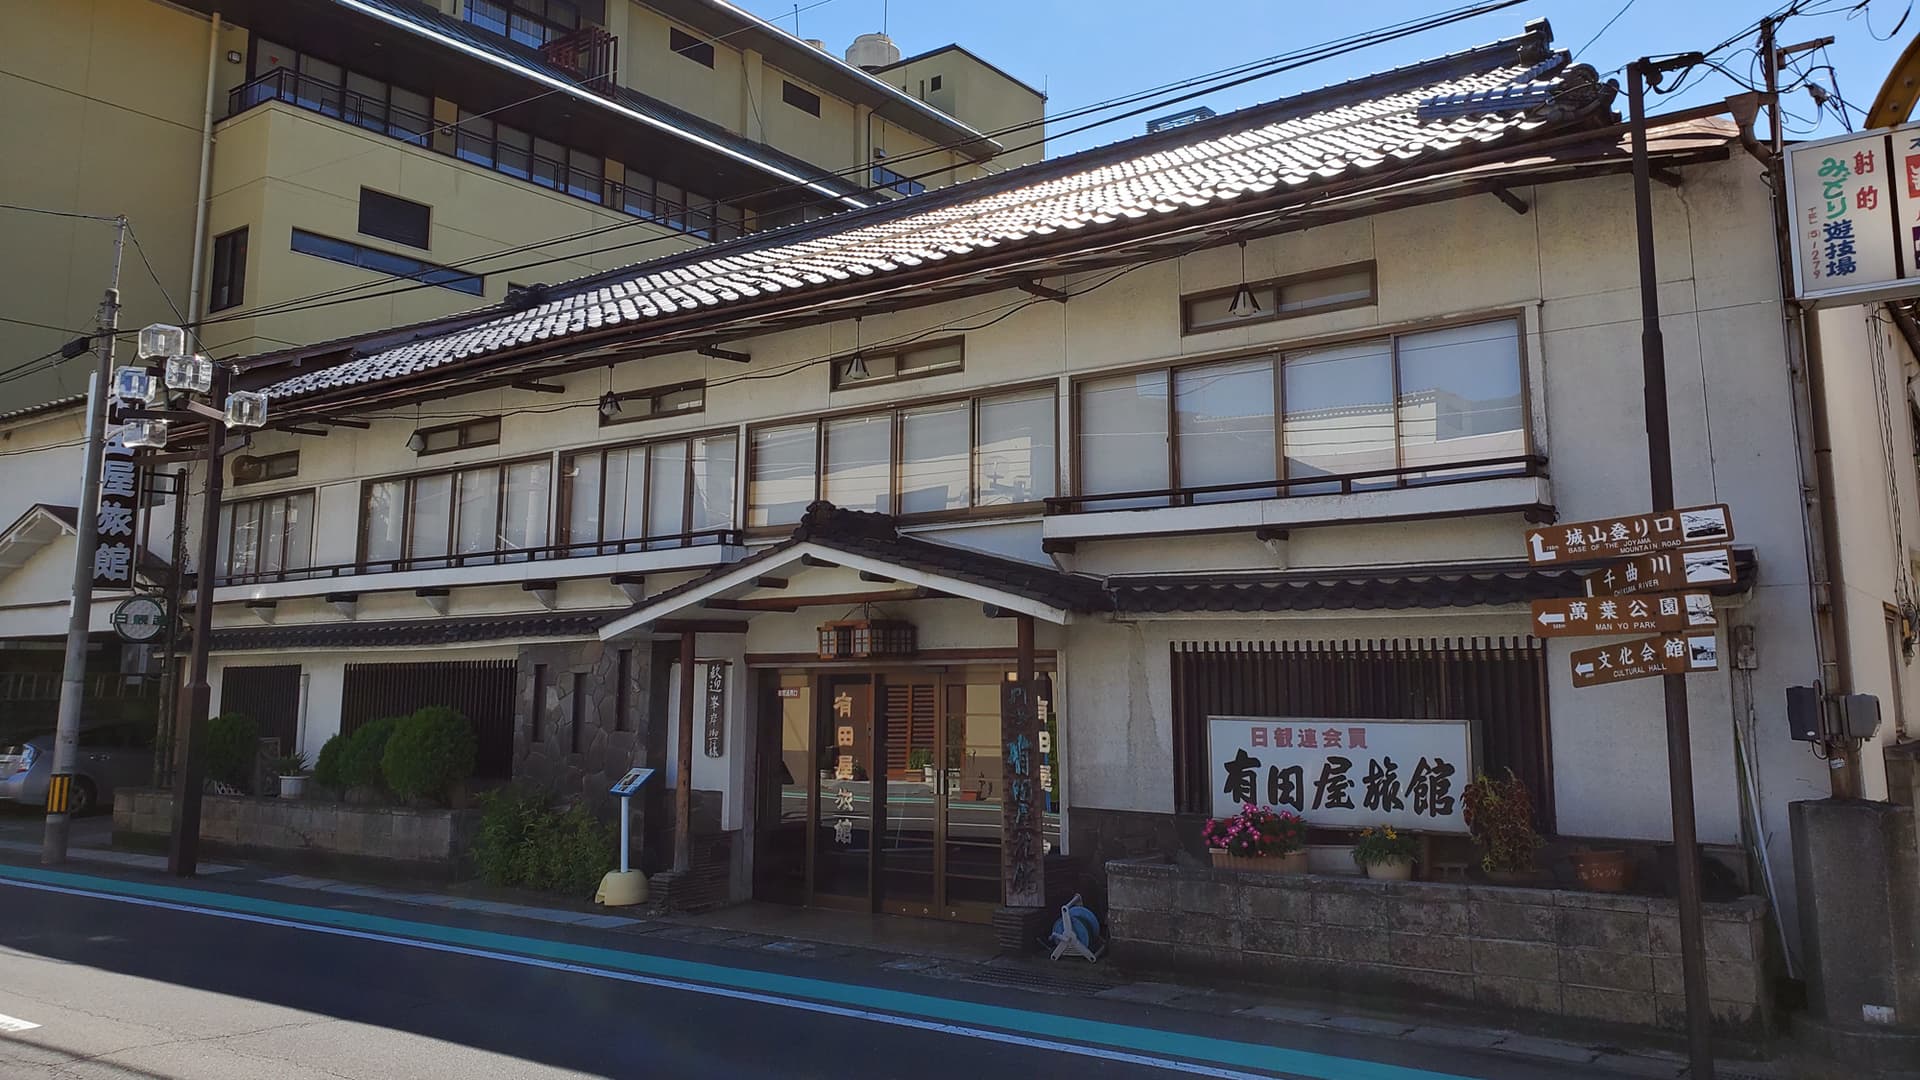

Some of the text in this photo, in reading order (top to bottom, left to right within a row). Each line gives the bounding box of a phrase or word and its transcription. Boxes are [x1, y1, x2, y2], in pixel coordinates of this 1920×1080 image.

[1853, 150, 1878, 211] 射的
[1818, 157, 1856, 277] みどり遊技場
[1564, 516, 1674, 547] 城山登り口
[1568, 538, 1651, 553] BASE OF THE JOYAMA
[1620, 539, 1681, 554] MOUNTAIN ROAD
[1603, 555, 1671, 589] 千曲川
[1568, 597, 1679, 621] 萬葉公園
[1595, 621, 1656, 631] MAN YO PARK
[1598, 638, 1685, 670] 文化会館
[1613, 663, 1666, 678] CULTURAL HALL
[1251, 727, 1368, 749] 日観連会員
[833, 691, 855, 844] 有田屋旅館
[1224, 748, 1456, 817] 有田屋旅館
